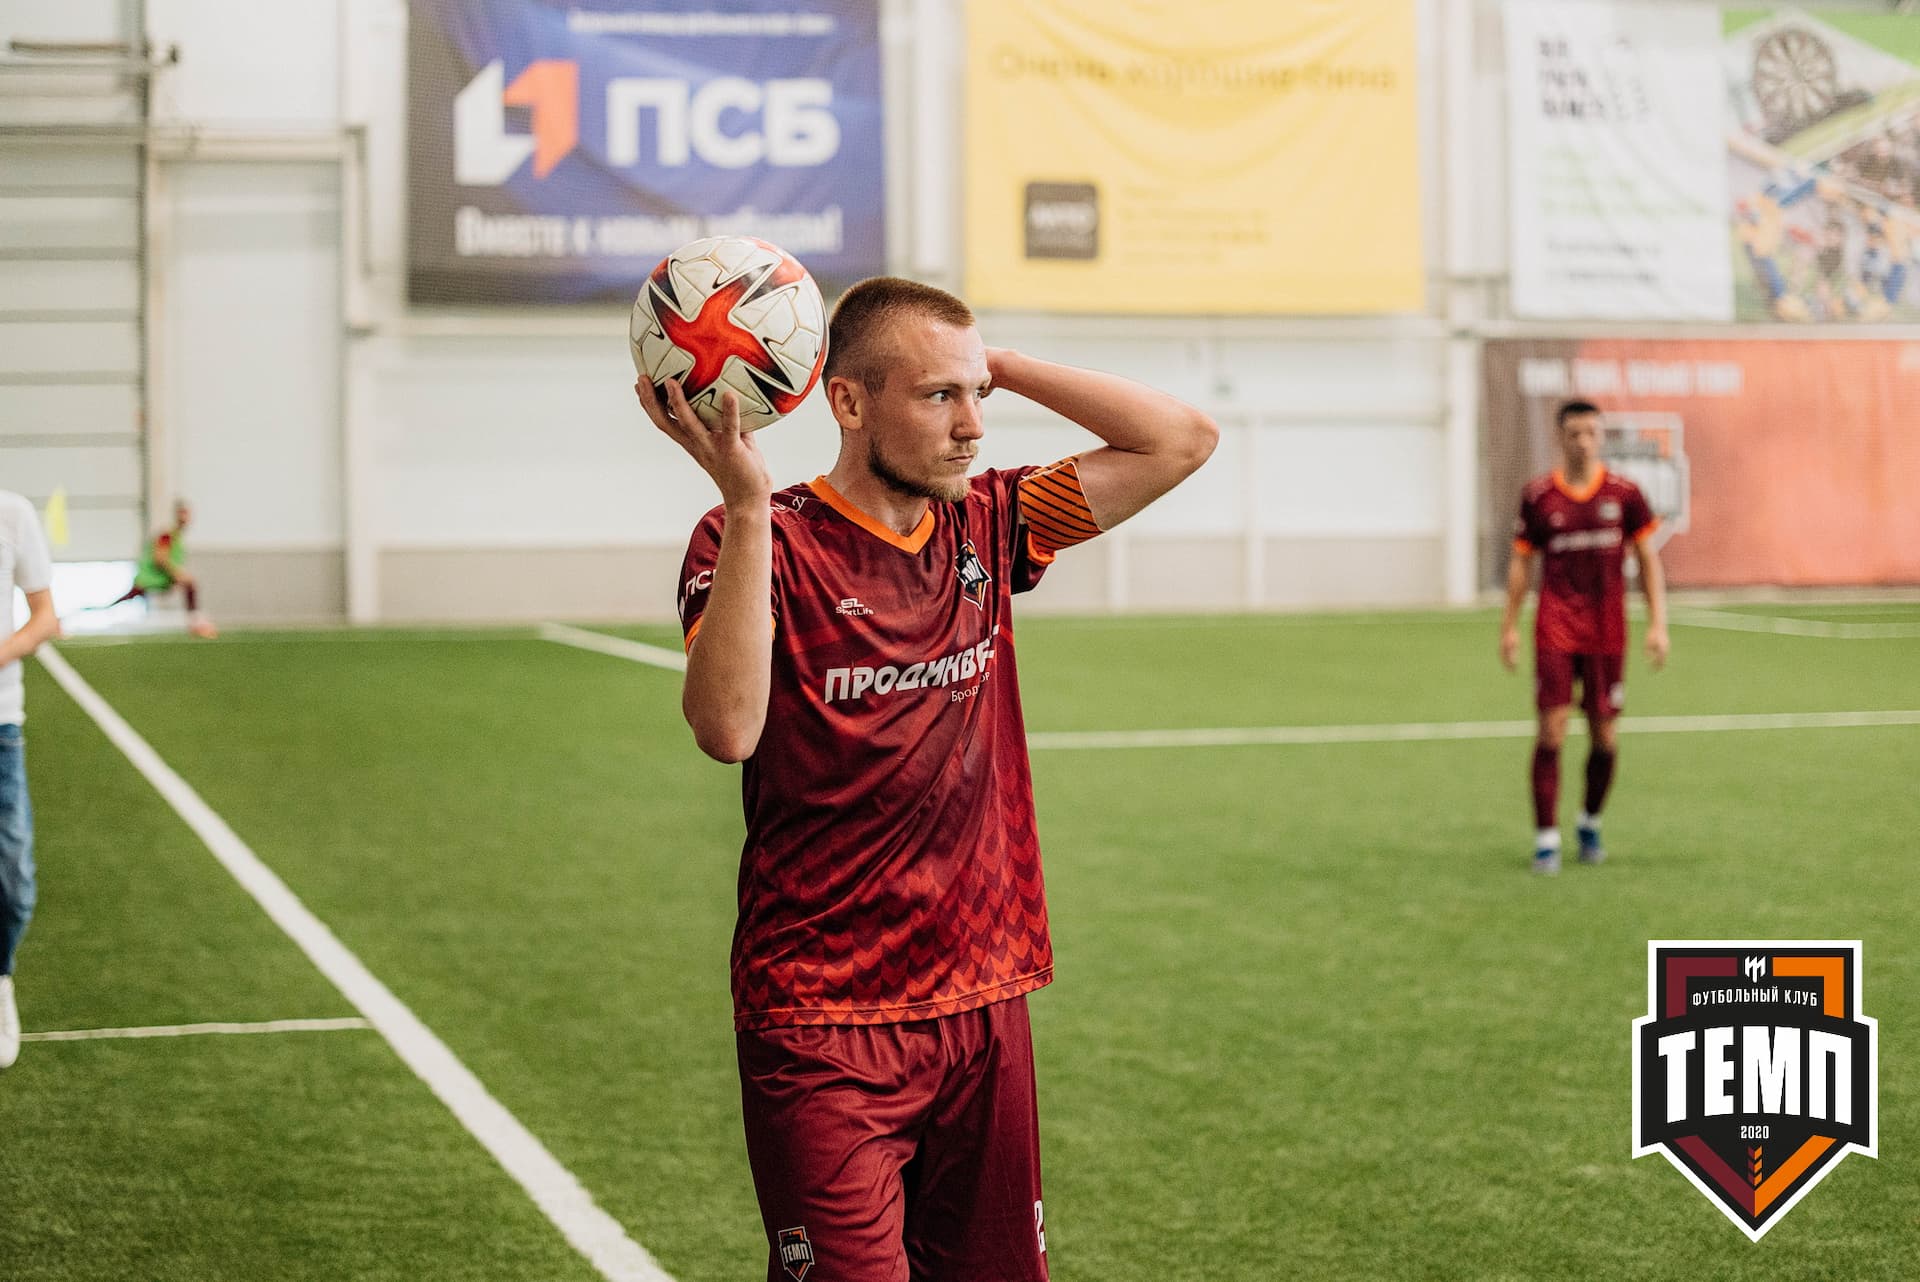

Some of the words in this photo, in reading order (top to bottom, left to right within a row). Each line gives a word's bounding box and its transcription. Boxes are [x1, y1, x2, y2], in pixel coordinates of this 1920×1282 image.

[606, 76, 841, 168] ПСБ
[685, 569, 717, 602] ПС
[782, 1242, 810, 1264] ТЕМП
